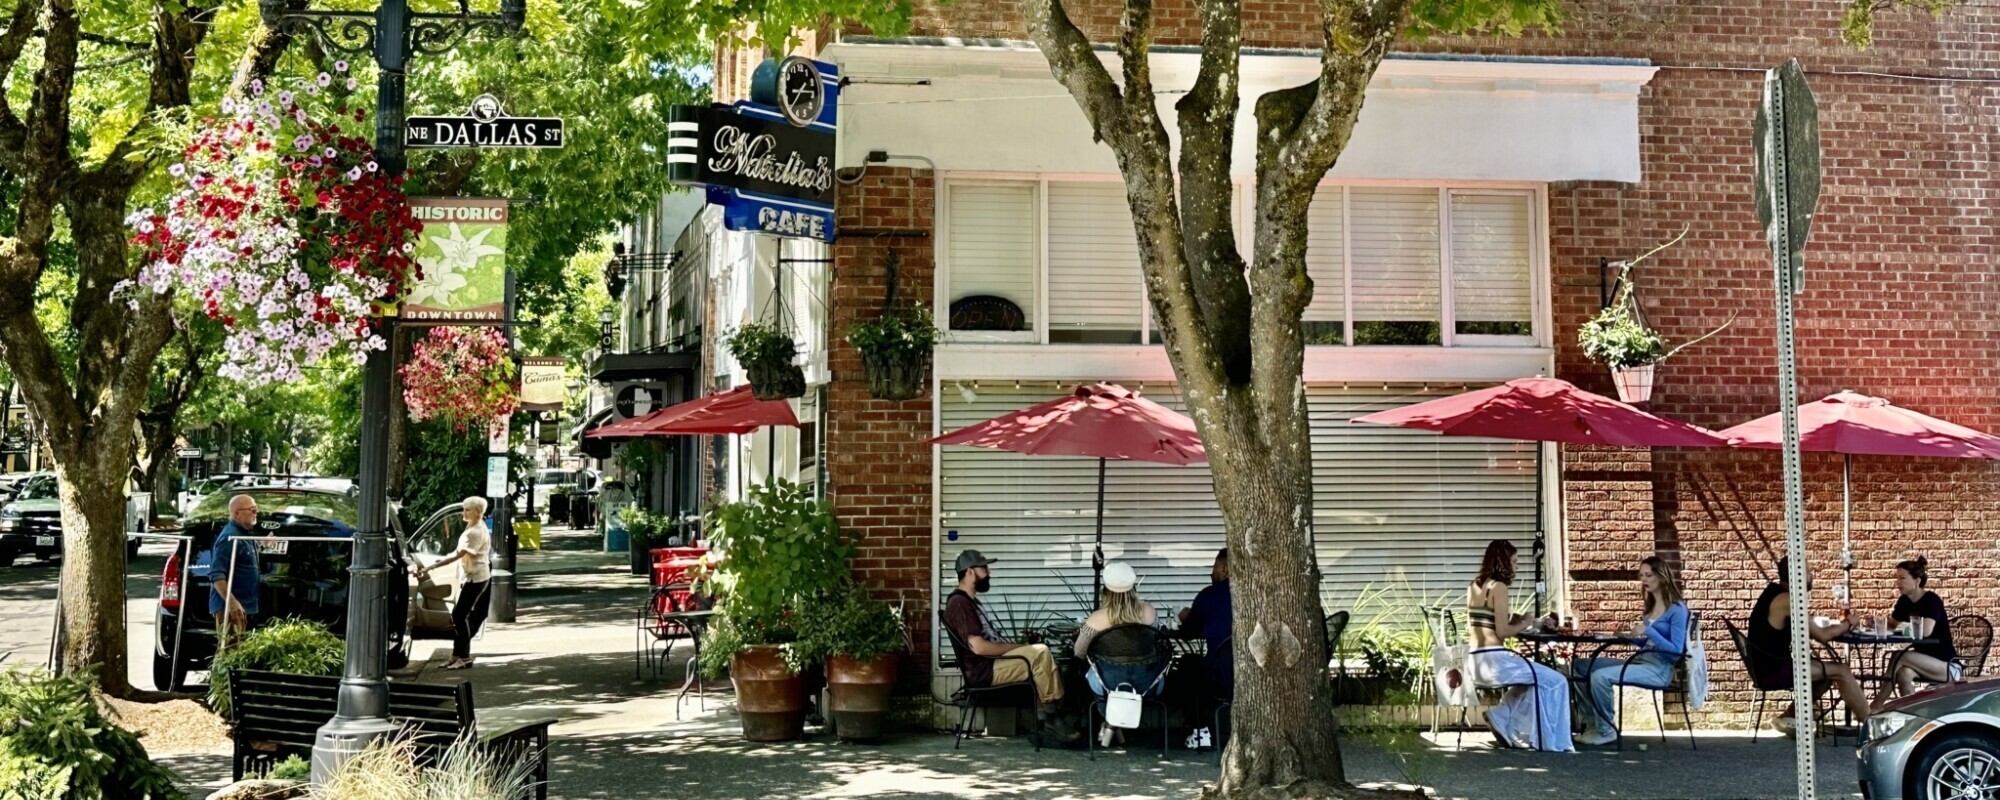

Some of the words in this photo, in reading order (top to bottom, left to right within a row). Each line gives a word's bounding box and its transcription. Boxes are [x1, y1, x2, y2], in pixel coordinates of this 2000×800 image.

[409, 127, 428, 139] NE
[434, 122, 537, 145] DALLAS
[544, 128, 560, 140] ST
[708, 125, 832, 191] Natalia's
[411, 206, 503, 220] HISTORIC
[758, 206, 825, 238] CAFE
[407, 311, 497, 320] DOWNTOWN
[524, 371, 561, 384] Camas
